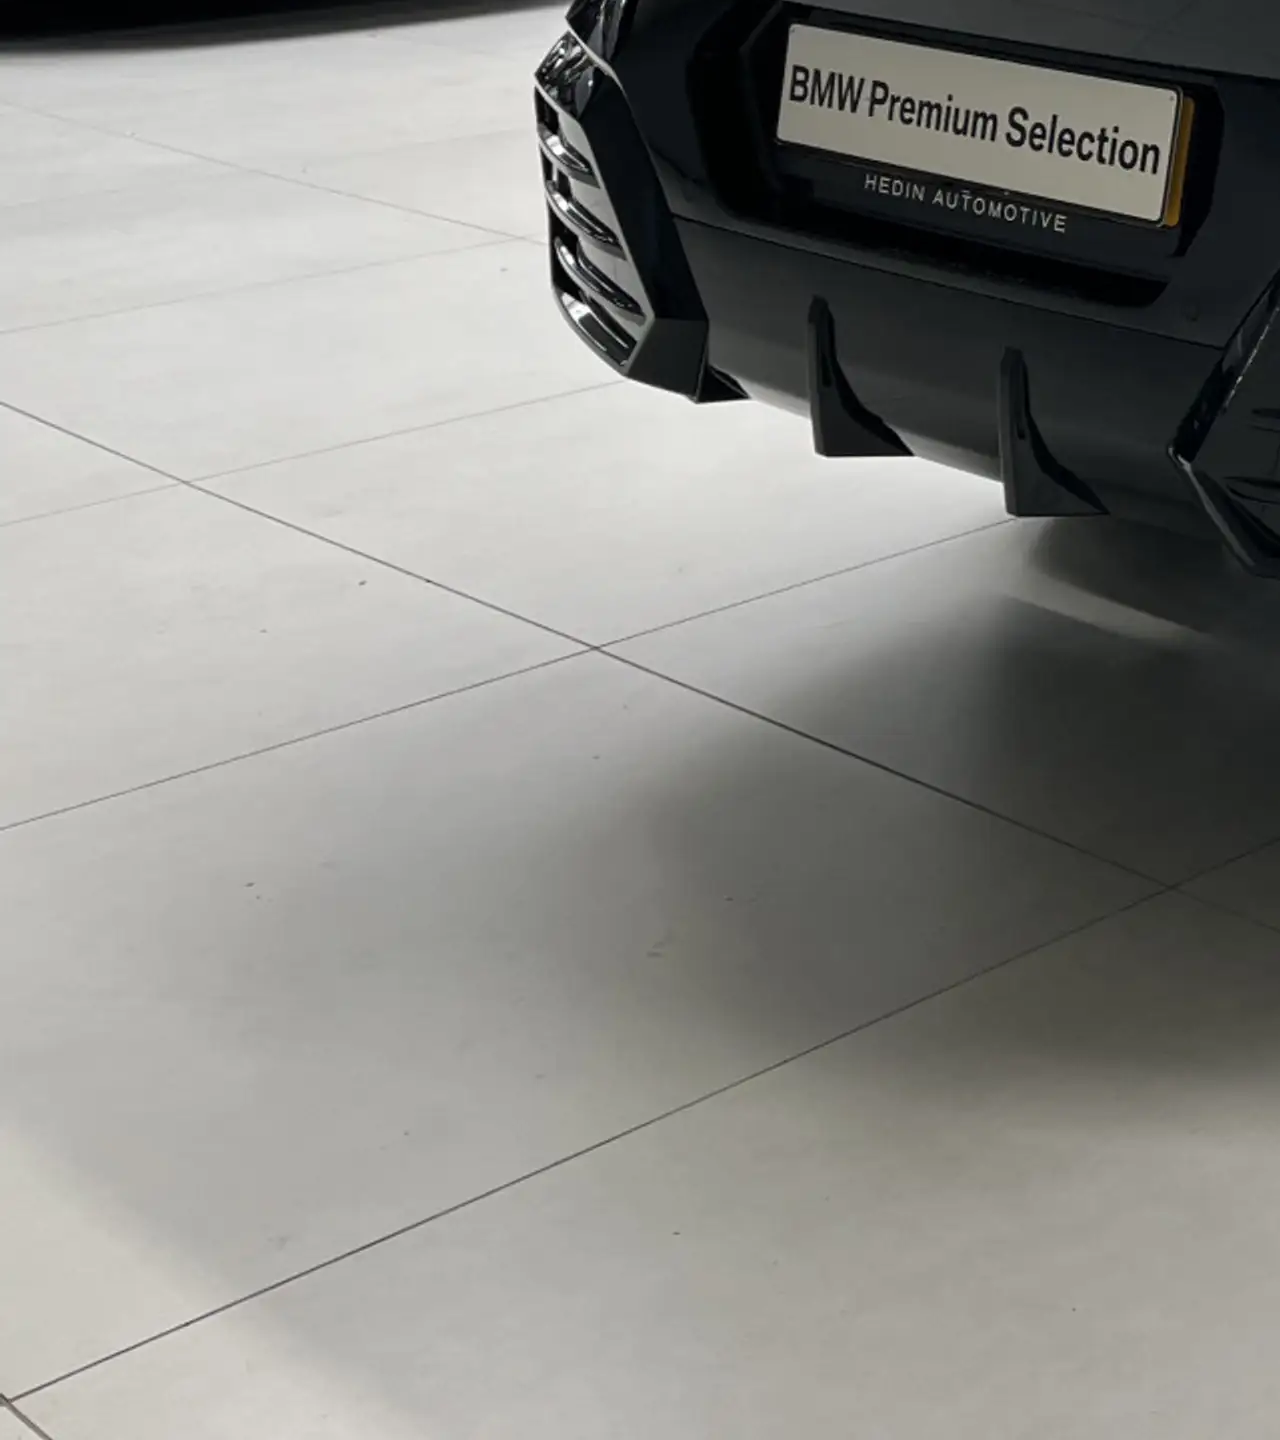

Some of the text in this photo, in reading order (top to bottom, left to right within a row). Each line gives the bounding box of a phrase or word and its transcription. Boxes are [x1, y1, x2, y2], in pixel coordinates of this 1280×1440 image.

[789, 64, 1161, 175] BMW Premium Selection
[863, 173, 1068, 233] HEDIN AUTOMOTIVE
